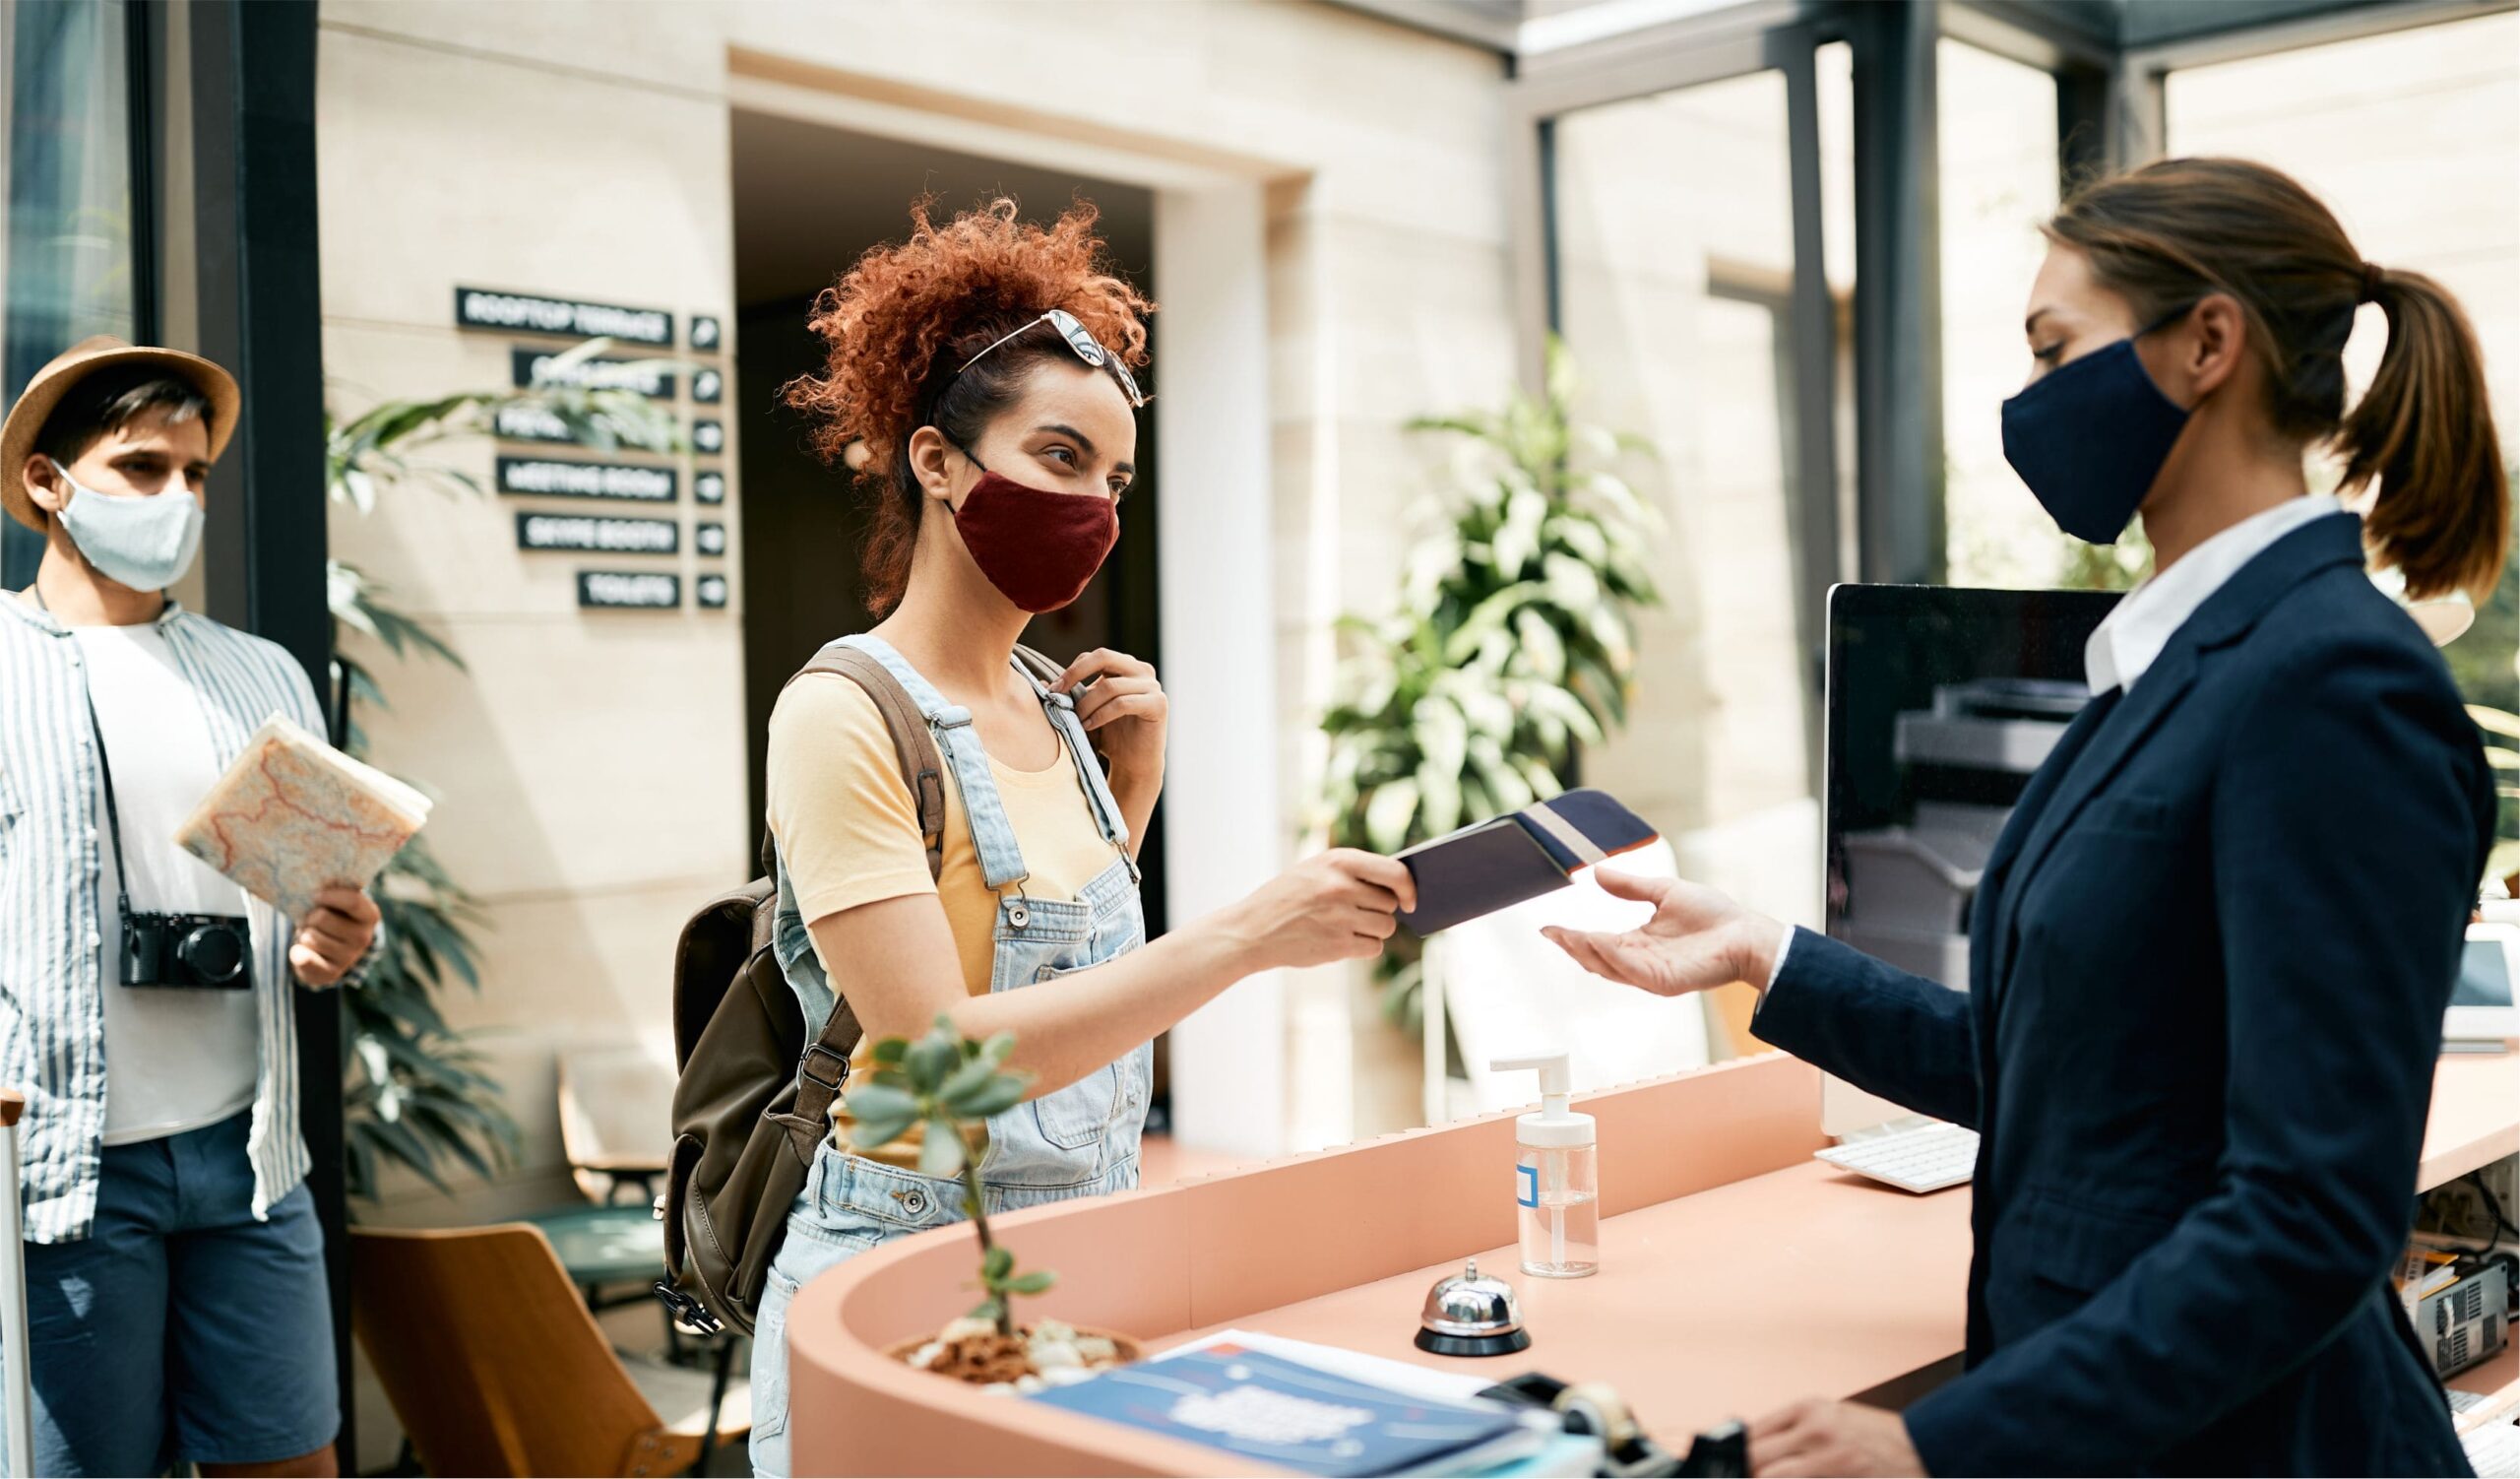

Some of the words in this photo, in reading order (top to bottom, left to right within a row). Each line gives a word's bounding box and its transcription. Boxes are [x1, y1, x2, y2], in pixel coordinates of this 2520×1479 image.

[465, 292, 573, 329] ROOFTOP
[574, 304, 666, 342] TERRACE
[506, 462, 601, 494] MEETING
[602, 467, 671, 498] ROOM
[526, 516, 595, 548] SKYPE
[596, 519, 675, 550] BOOTH
[587, 573, 675, 606] TOILETS
